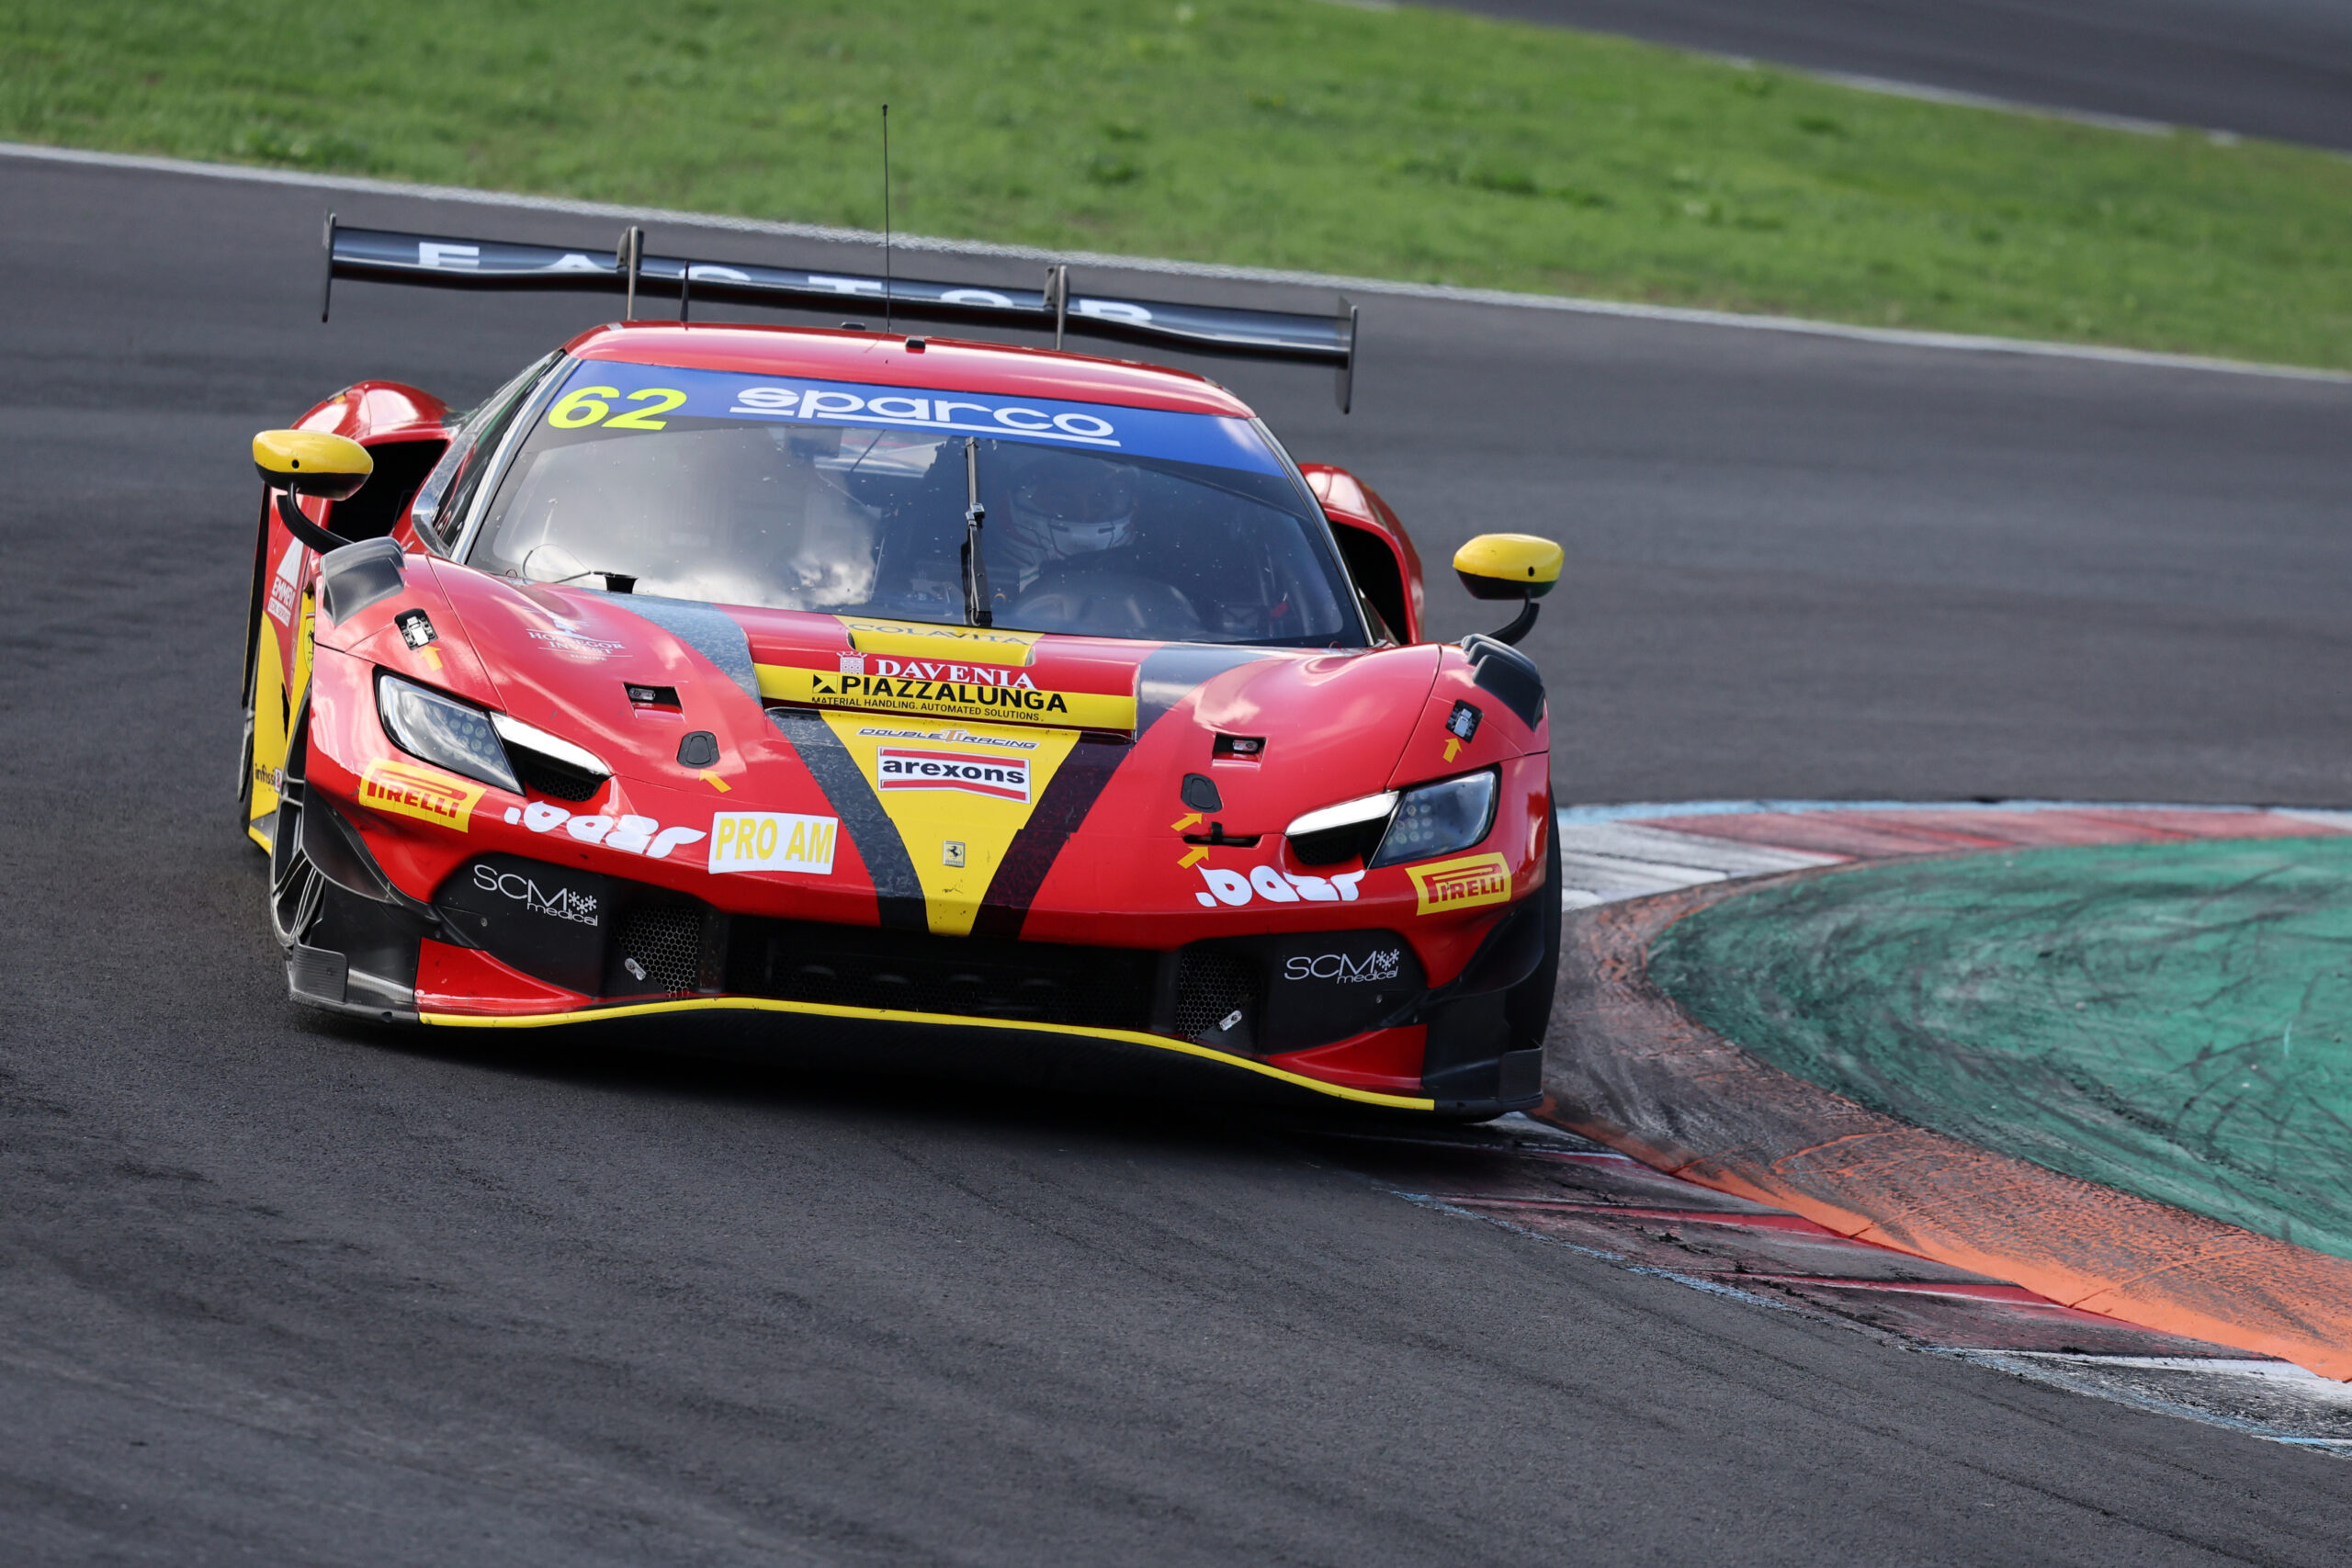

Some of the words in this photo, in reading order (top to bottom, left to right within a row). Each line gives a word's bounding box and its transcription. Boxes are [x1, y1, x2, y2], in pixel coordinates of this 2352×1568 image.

[548, 386, 687, 430] 62
[736, 386, 1115, 441] sparco
[849, 624, 1030, 646] COLAVITA
[876, 659, 1037, 690] DAVENIA
[812, 696, 860, 707] MATERIAL
[865, 699, 918, 710] HANDLING.
[921, 702, 980, 716] AUTOMATED
[842, 675, 1068, 714] PIAZZALUNGA
[882, 760, 1025, 784] arexons
[368, 768, 468, 818] PIRELLI
[715, 818, 778, 861] PRO
[785, 821, 835, 864] AM
[473, 863, 569, 912] SCM
[1421, 863, 1505, 904] PIRELLI
[526, 900, 598, 927] medical
[1284, 950, 1378, 981] SCM
[1336, 965, 1398, 985] medical
